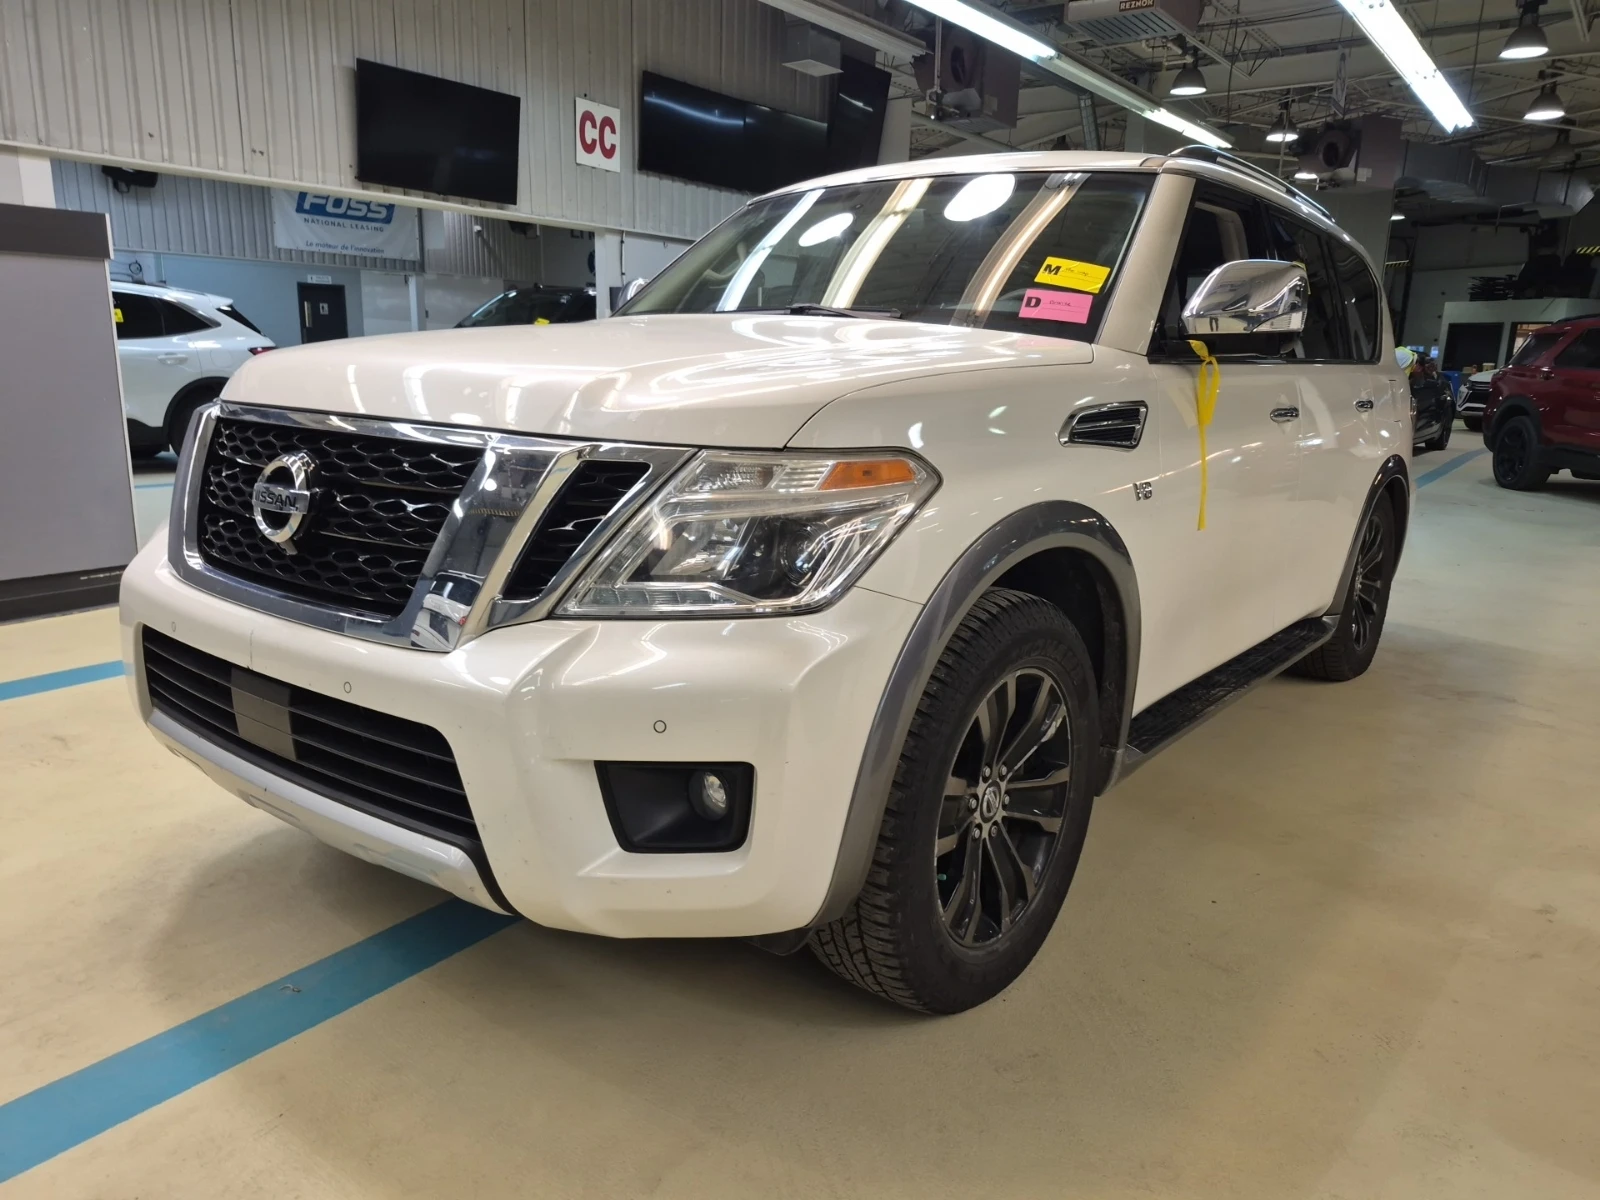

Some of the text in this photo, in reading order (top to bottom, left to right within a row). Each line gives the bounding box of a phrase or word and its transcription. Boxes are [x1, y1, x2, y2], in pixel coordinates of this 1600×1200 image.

[1120, 0, 1153, 10] REZNOR
[579, 110, 616, 159] CC
[303, 193, 388, 219] FOSS
[304, 217, 384, 232] NATIONAL LEASING
[315, 242, 339, 250] moteur
[340, 242, 349, 251] de
[351, 243, 385, 253] l'innovation
[1043, 264, 1062, 275] M
[1025, 297, 1042, 308] D
